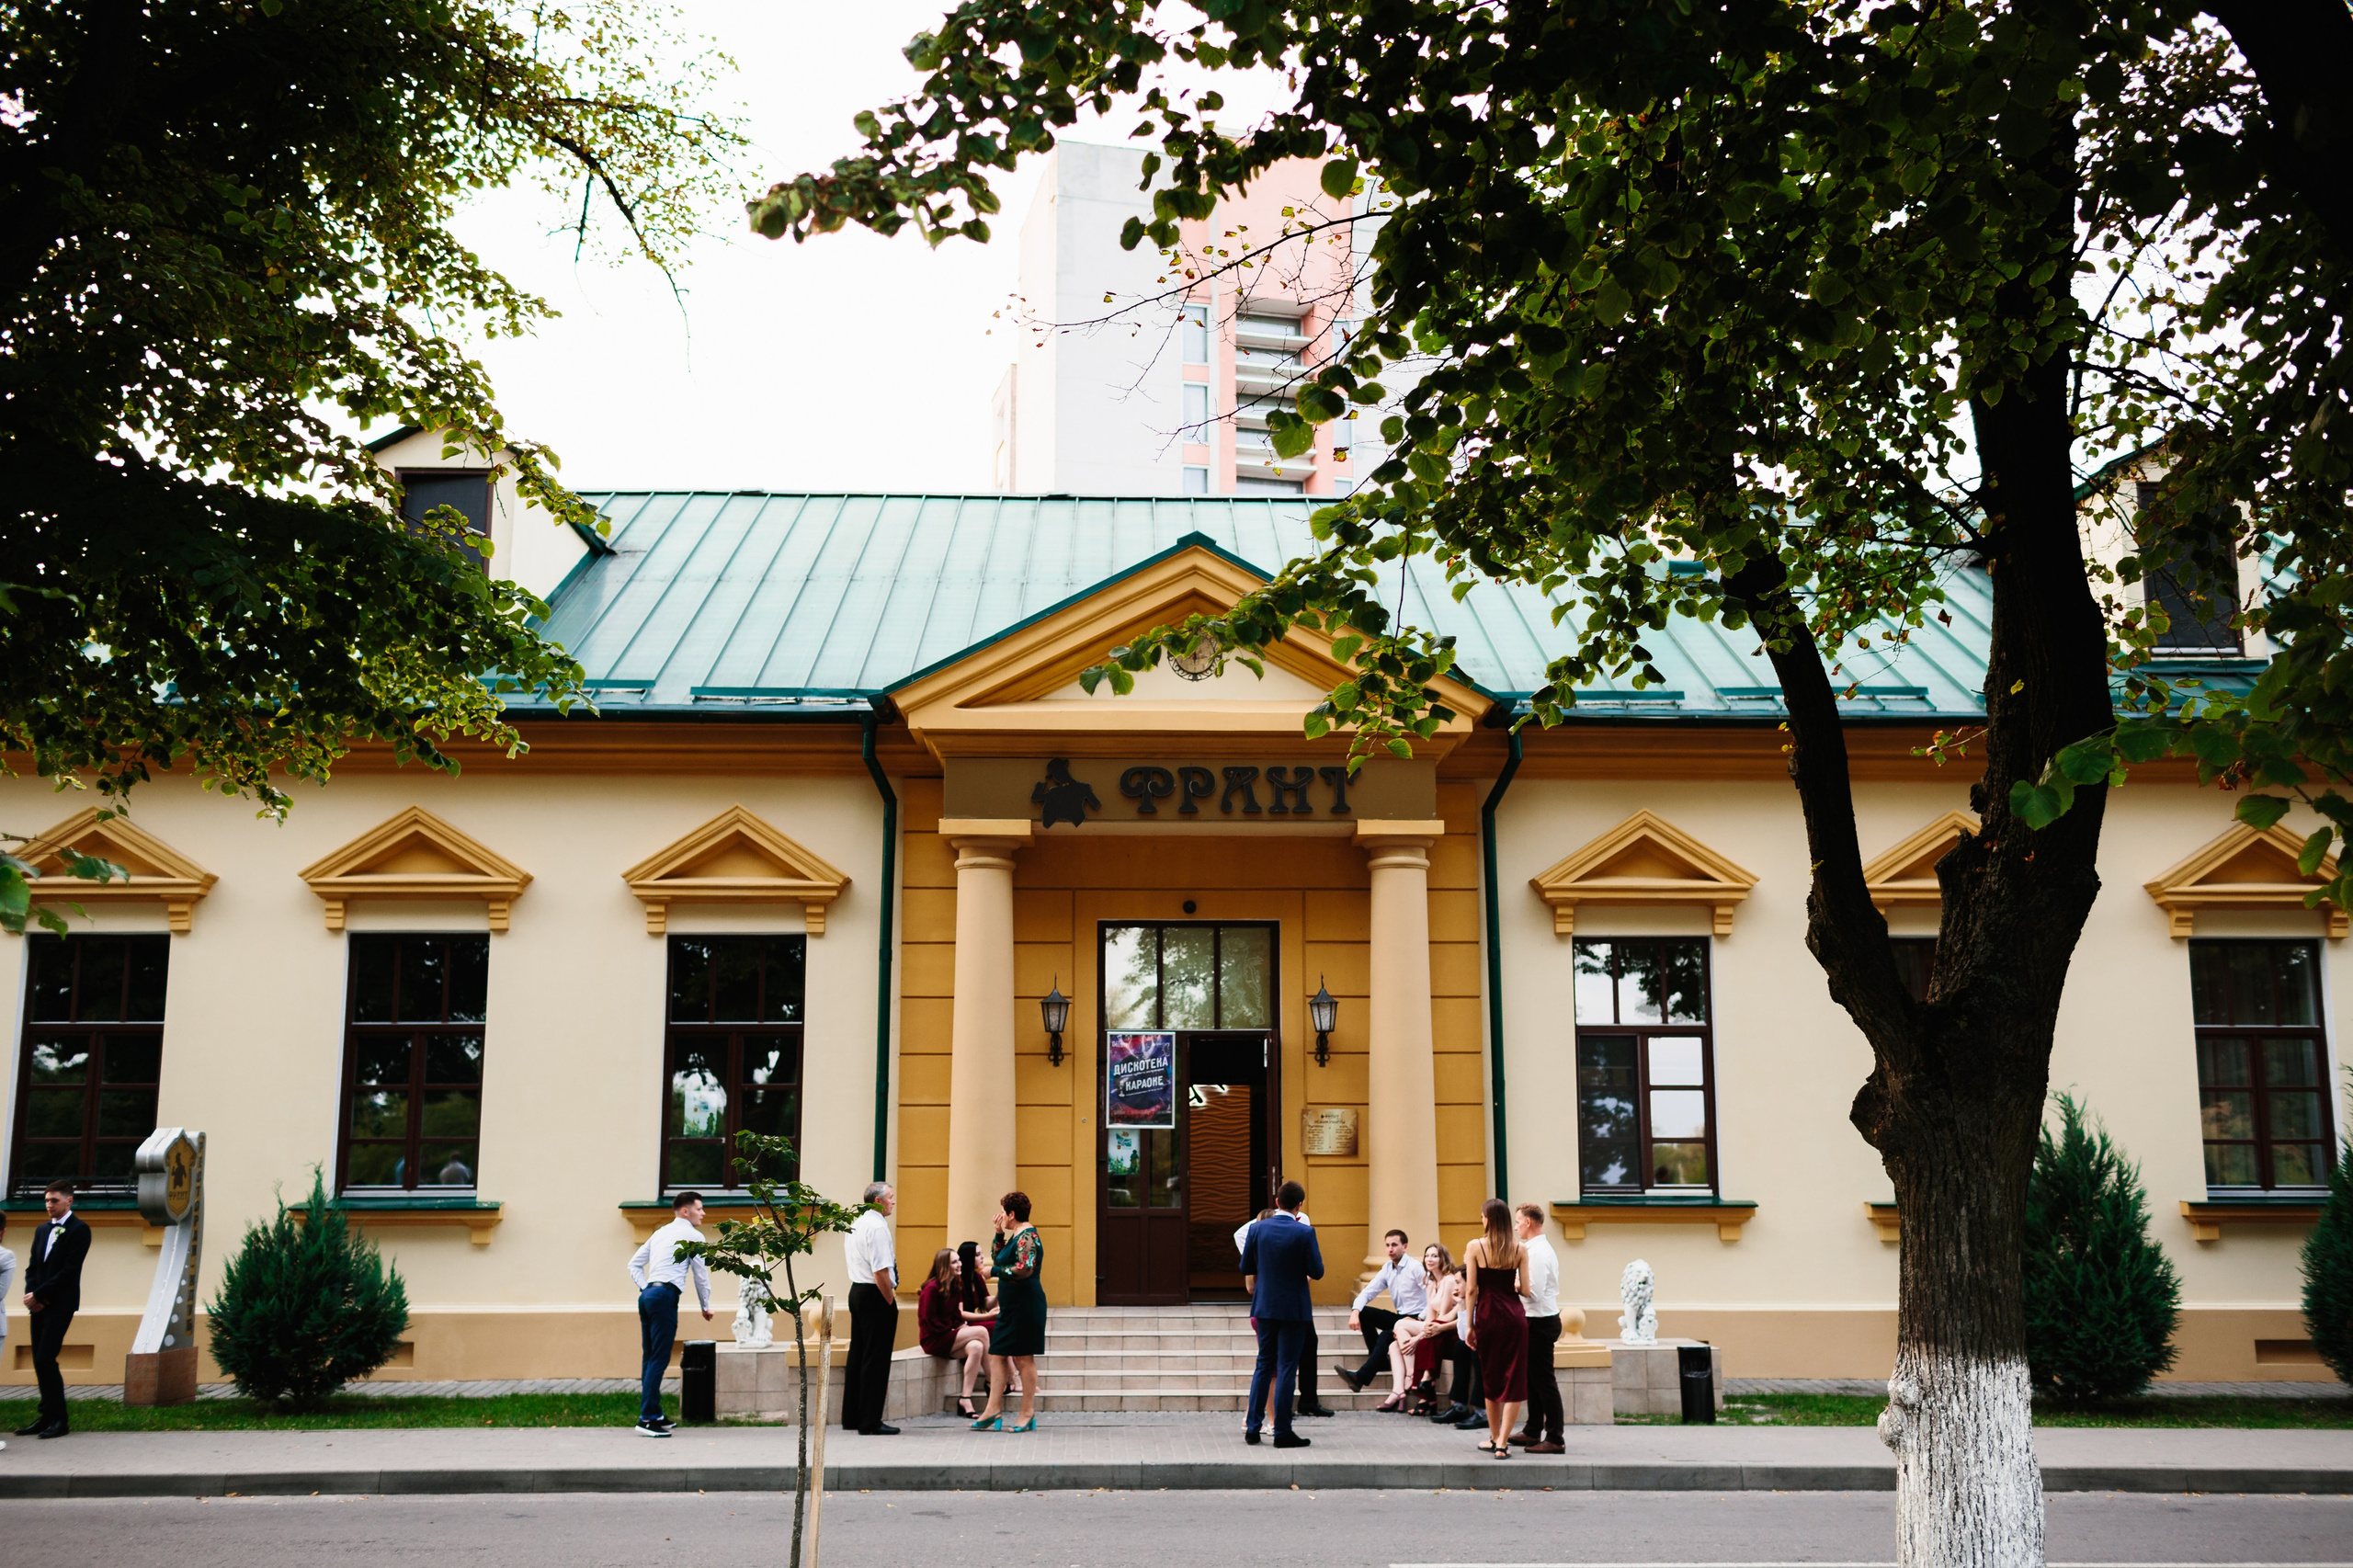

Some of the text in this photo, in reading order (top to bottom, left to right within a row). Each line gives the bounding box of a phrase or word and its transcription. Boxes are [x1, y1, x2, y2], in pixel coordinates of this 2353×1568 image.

[1120, 767, 1362, 812] ФРАНТ
[1113, 1057, 1168, 1075] ДИСКОТЕКА
[1126, 1076, 1164, 1091] КАРАОКЕ
